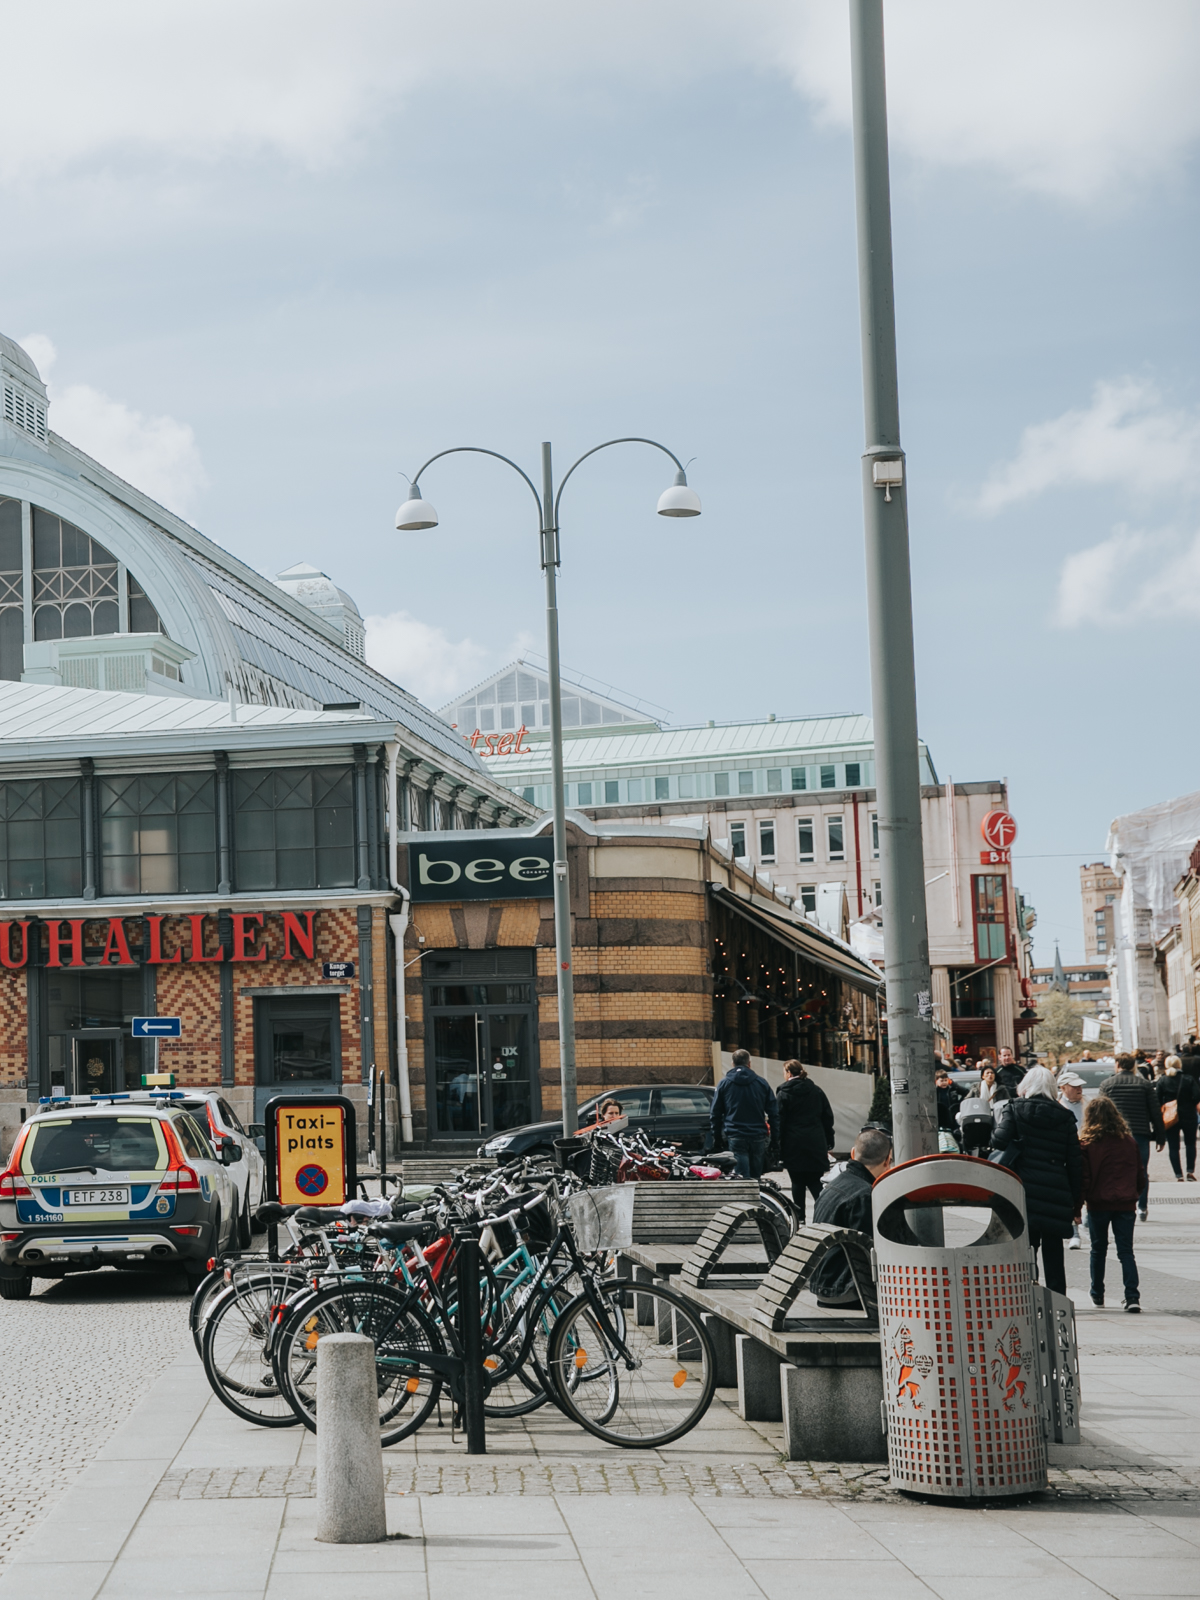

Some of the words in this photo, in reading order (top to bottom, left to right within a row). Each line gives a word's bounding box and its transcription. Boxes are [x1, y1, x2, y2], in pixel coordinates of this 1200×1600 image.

[418, 853, 551, 885] bee
[285, 1114, 336, 1130] Taxi-
[288, 1135, 335, 1153] plats
[31, 1175, 57, 1183] POLIS
[73, 1191, 96, 1203] ETF
[100, 1190, 124, 1202] 238
[28, 1214, 32, 1222] 1
[35, 1213, 63, 1222] 51-1160
[1056, 1309, 1076, 1430] PANTAMERA
